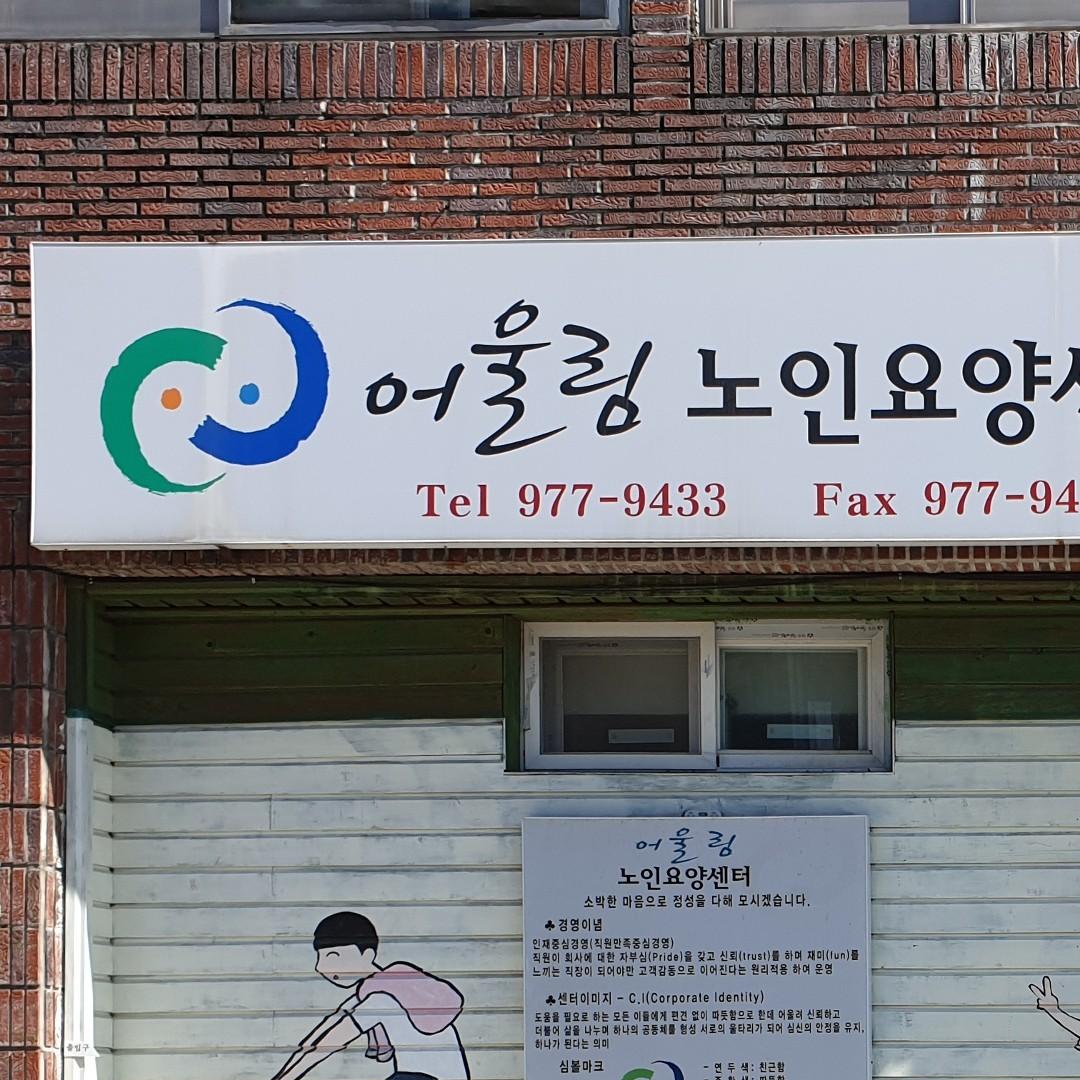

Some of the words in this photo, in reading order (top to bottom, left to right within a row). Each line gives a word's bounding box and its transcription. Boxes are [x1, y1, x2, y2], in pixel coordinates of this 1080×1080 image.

[366, 299, 652, 455] 어울림
[417, 485, 489, 517] Tel
[519, 483, 725, 517] 977-9433
[814, 483, 897, 516] Fax
[636, 828, 736, 864] 어울림
[618, 865, 750, 890] 노인요양센터
[584, 895, 616, 909] 소박한
[623, 895, 667, 908] 마음으로
[673, 894, 706, 908] 정성을
[712, 894, 732, 907] 다해
[738, 893, 810, 907] 모시겠습니다.
[559, 918, 602, 932] 경영이념
[533, 952, 559, 964] 직원이
[565, 952, 592, 963] 회사에
[598, 952, 615, 963] 대한
[698, 951, 715, 962] 갖고
[785, 950, 802, 961] 하며
[533, 966, 560, 977] 느끼는
[565, 966, 592, 977] 직장이
[597, 965, 634, 976] 되어야만
[639, 965, 695, 976] 고객감동으로
[700, 964, 746, 976] 이어진다는
[751, 964, 788, 975] 원리적용
[793, 964, 810, 975] 하여
[815, 963, 832, 974] 운영
[558, 992, 611, 1005] 센터이미지
[715, 990, 764, 1004] Identity)
[535, 1012, 559, 1023] 도움을
[564, 1012, 589, 1022] 필요로
[593, 1012, 609, 1022] 하는
[613, 1011, 629, 1022] 모든
[634, 1011, 667, 1022] 이들에게
[672, 1011, 687, 1021] 편견
[692, 1010, 707, 1021] 없이
[712, 1010, 754, 1021] 따뜻함으로
[758, 1010, 774, 1020] 한데
[778, 1009, 802, 1020] 어울려
[807, 1009, 840, 1020] 신뢰하고
[585, 1025, 608, 1036] 나누며
[614, 1024, 638, 1035] 하나의
[642, 1024, 675, 1035] 공동체를
[680, 1024, 696, 1035] 형성
[701, 1024, 725, 1034] 서로의
[729, 1023, 762, 1034] 울타리가
[767, 1023, 782, 1034] 되어
[787, 1023, 811, 1034] 심신의
[816, 1022, 840, 1033] 안정을
[844, 1022, 864, 1033] 유지,
[535, 1039, 560, 1050] 하나가
[564, 1038, 589, 1049] 된다는
[593, 1038, 609, 1049] 의미
[560, 1060, 604, 1073] 심볼마크
[760, 1062, 785, 1073] 친근함
